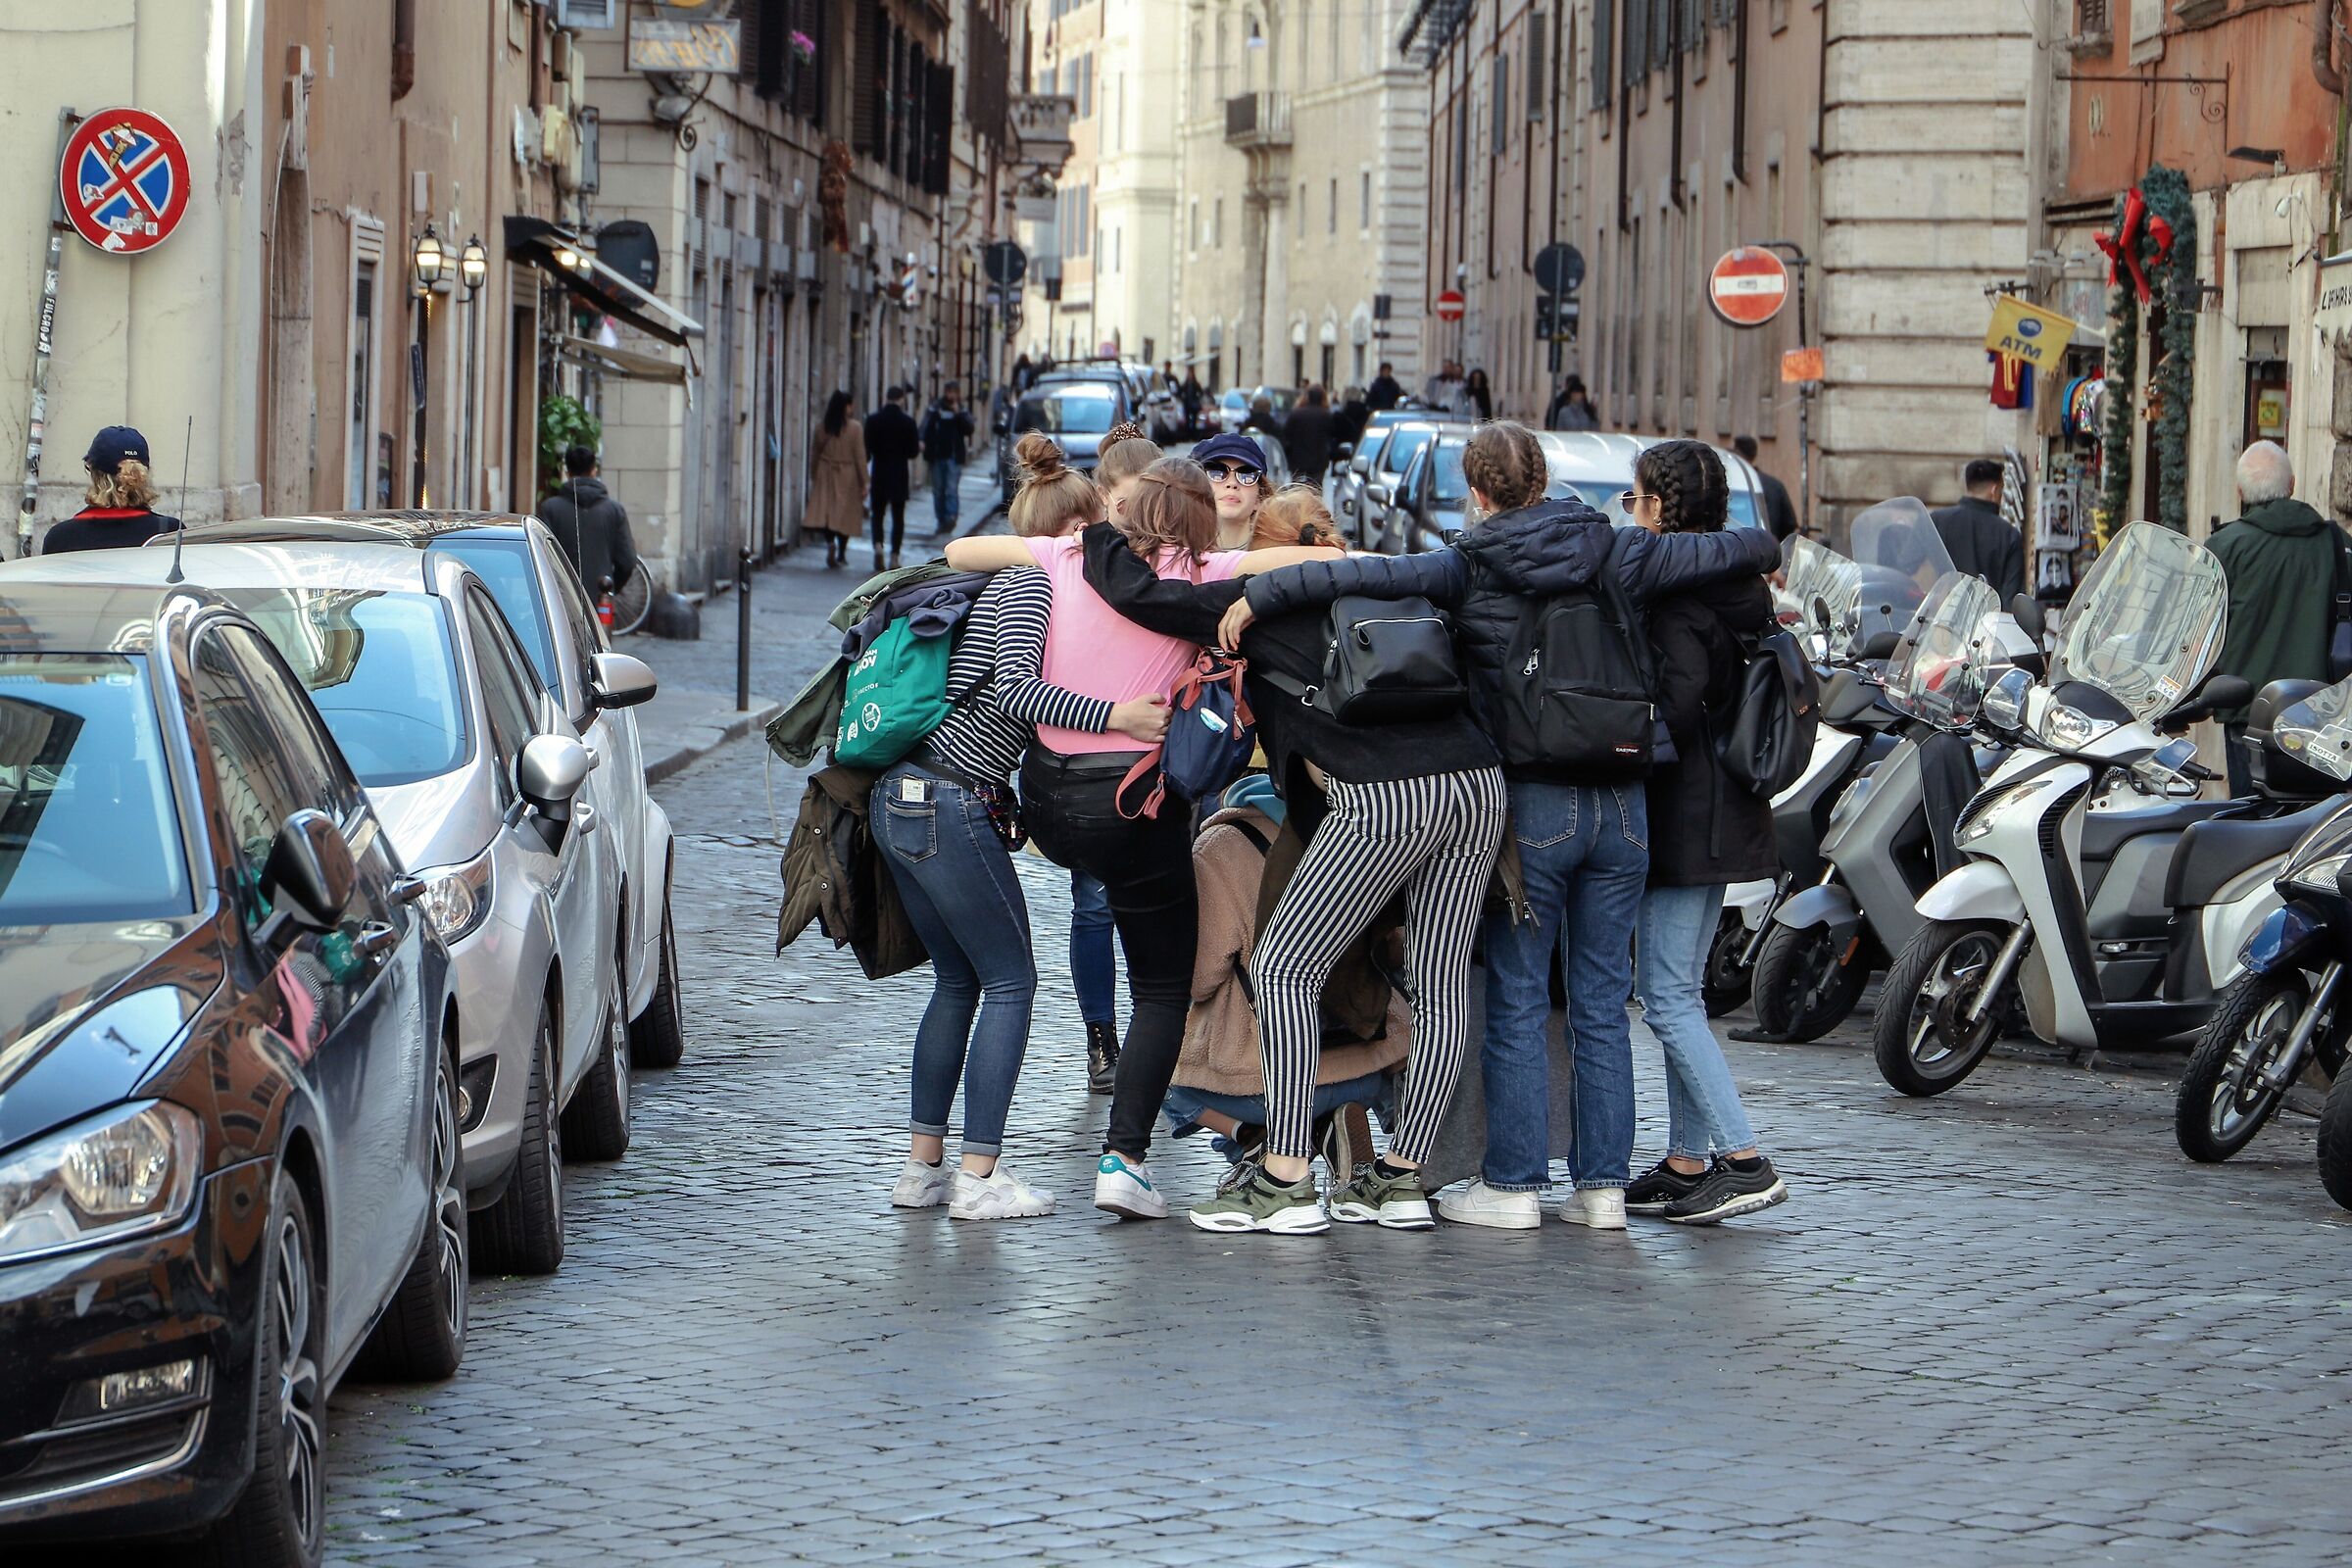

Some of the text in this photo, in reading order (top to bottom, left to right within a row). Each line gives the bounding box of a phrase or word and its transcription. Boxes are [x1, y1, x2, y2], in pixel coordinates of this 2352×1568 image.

[1999, 334, 2042, 360] ATM
[2087, 674, 2111, 688] HONDA
[2309, 744, 2338, 761] ISOTTA
